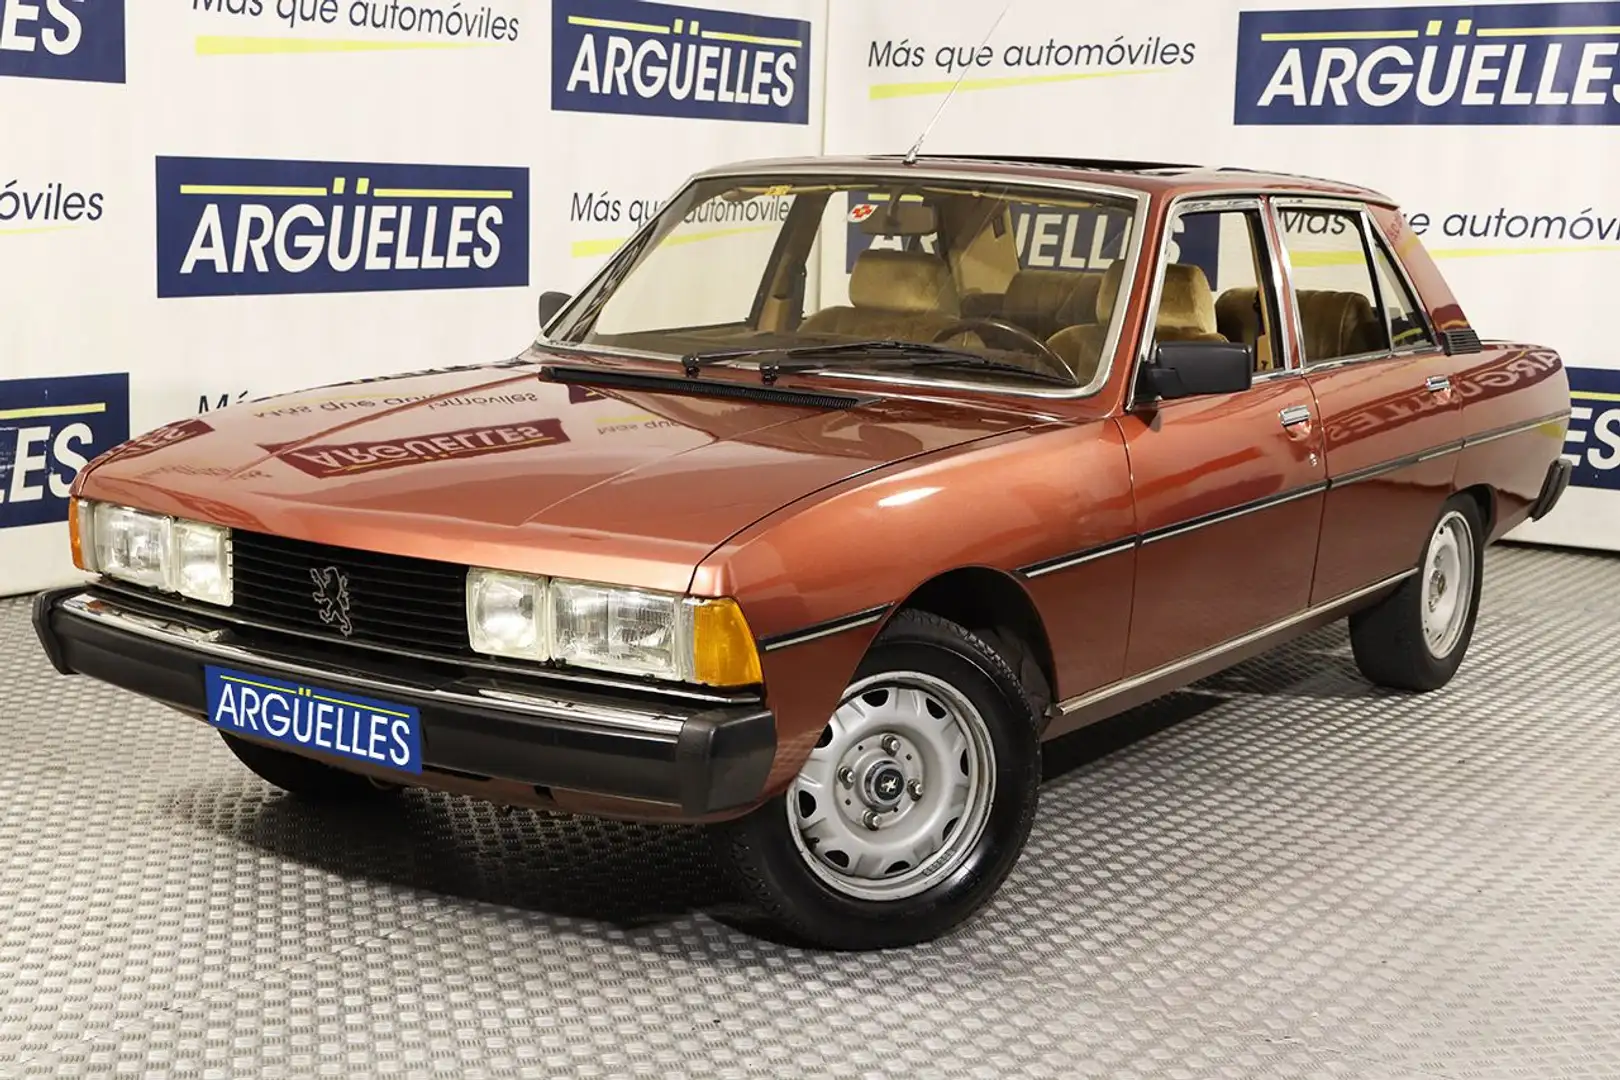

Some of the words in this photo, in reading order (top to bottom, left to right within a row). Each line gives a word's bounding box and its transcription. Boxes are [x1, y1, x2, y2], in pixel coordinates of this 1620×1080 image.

[276, 0, 338, 28] que
[349, 0, 519, 41] automóviles
[868, 38, 925, 68] Más
[935, 45, 994, 74] que
[1003, 36, 1196, 67] automóviles
[566, 18, 797, 108] ARGÜELLES
[1257, 19, 1620, 107] ARGÜELLE
[179, 177, 504, 274] ARGÜELLES
[569, 191, 622, 223] Más
[629, 200, 666, 229] qu
[0, 422, 93, 504] ES
[215, 683, 410, 766] ARGÜELLES
